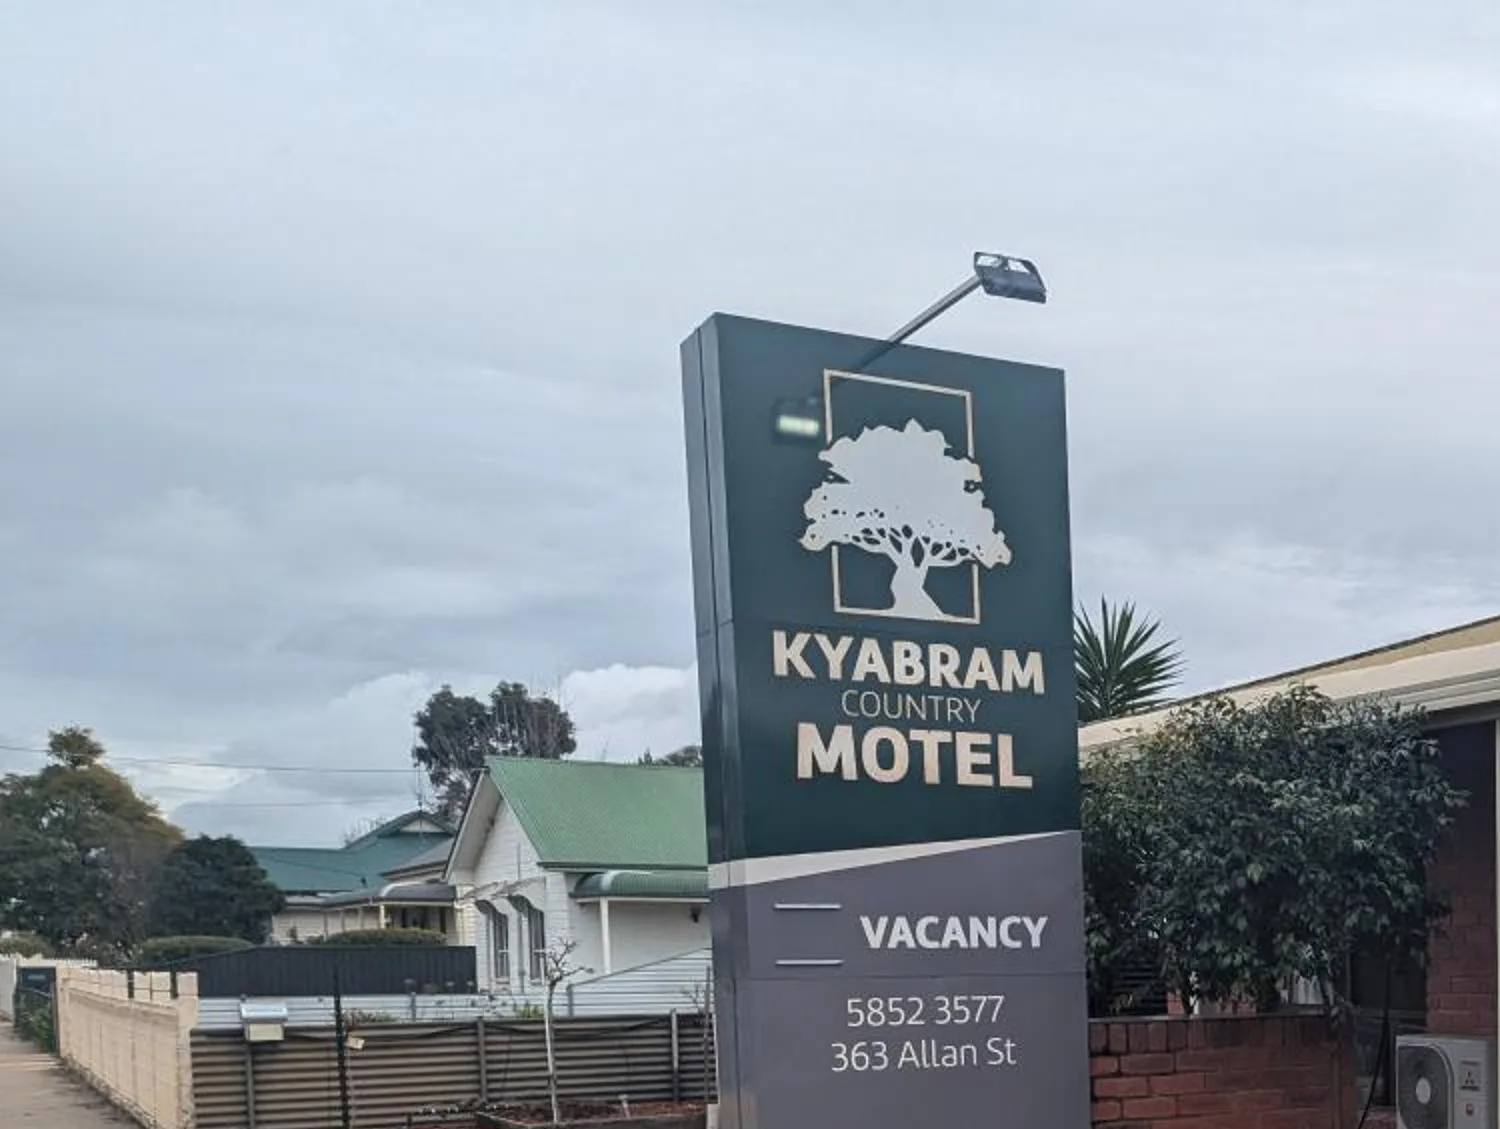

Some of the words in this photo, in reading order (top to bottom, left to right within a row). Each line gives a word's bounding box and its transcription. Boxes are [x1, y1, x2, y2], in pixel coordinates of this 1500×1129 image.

[773, 630, 1045, 694] KYABRAM
[841, 689, 981, 723] COUNTRY
[797, 722, 1033, 788] MOTEL
[859, 915, 1048, 949] VACANCY
[847, 996, 925, 1027] 5852
[934, 995, 1005, 1025] 3577
[831, 1041, 889, 1072] 363
[897, 1039, 977, 1069] Allan
[986, 1037, 1017, 1065] St
